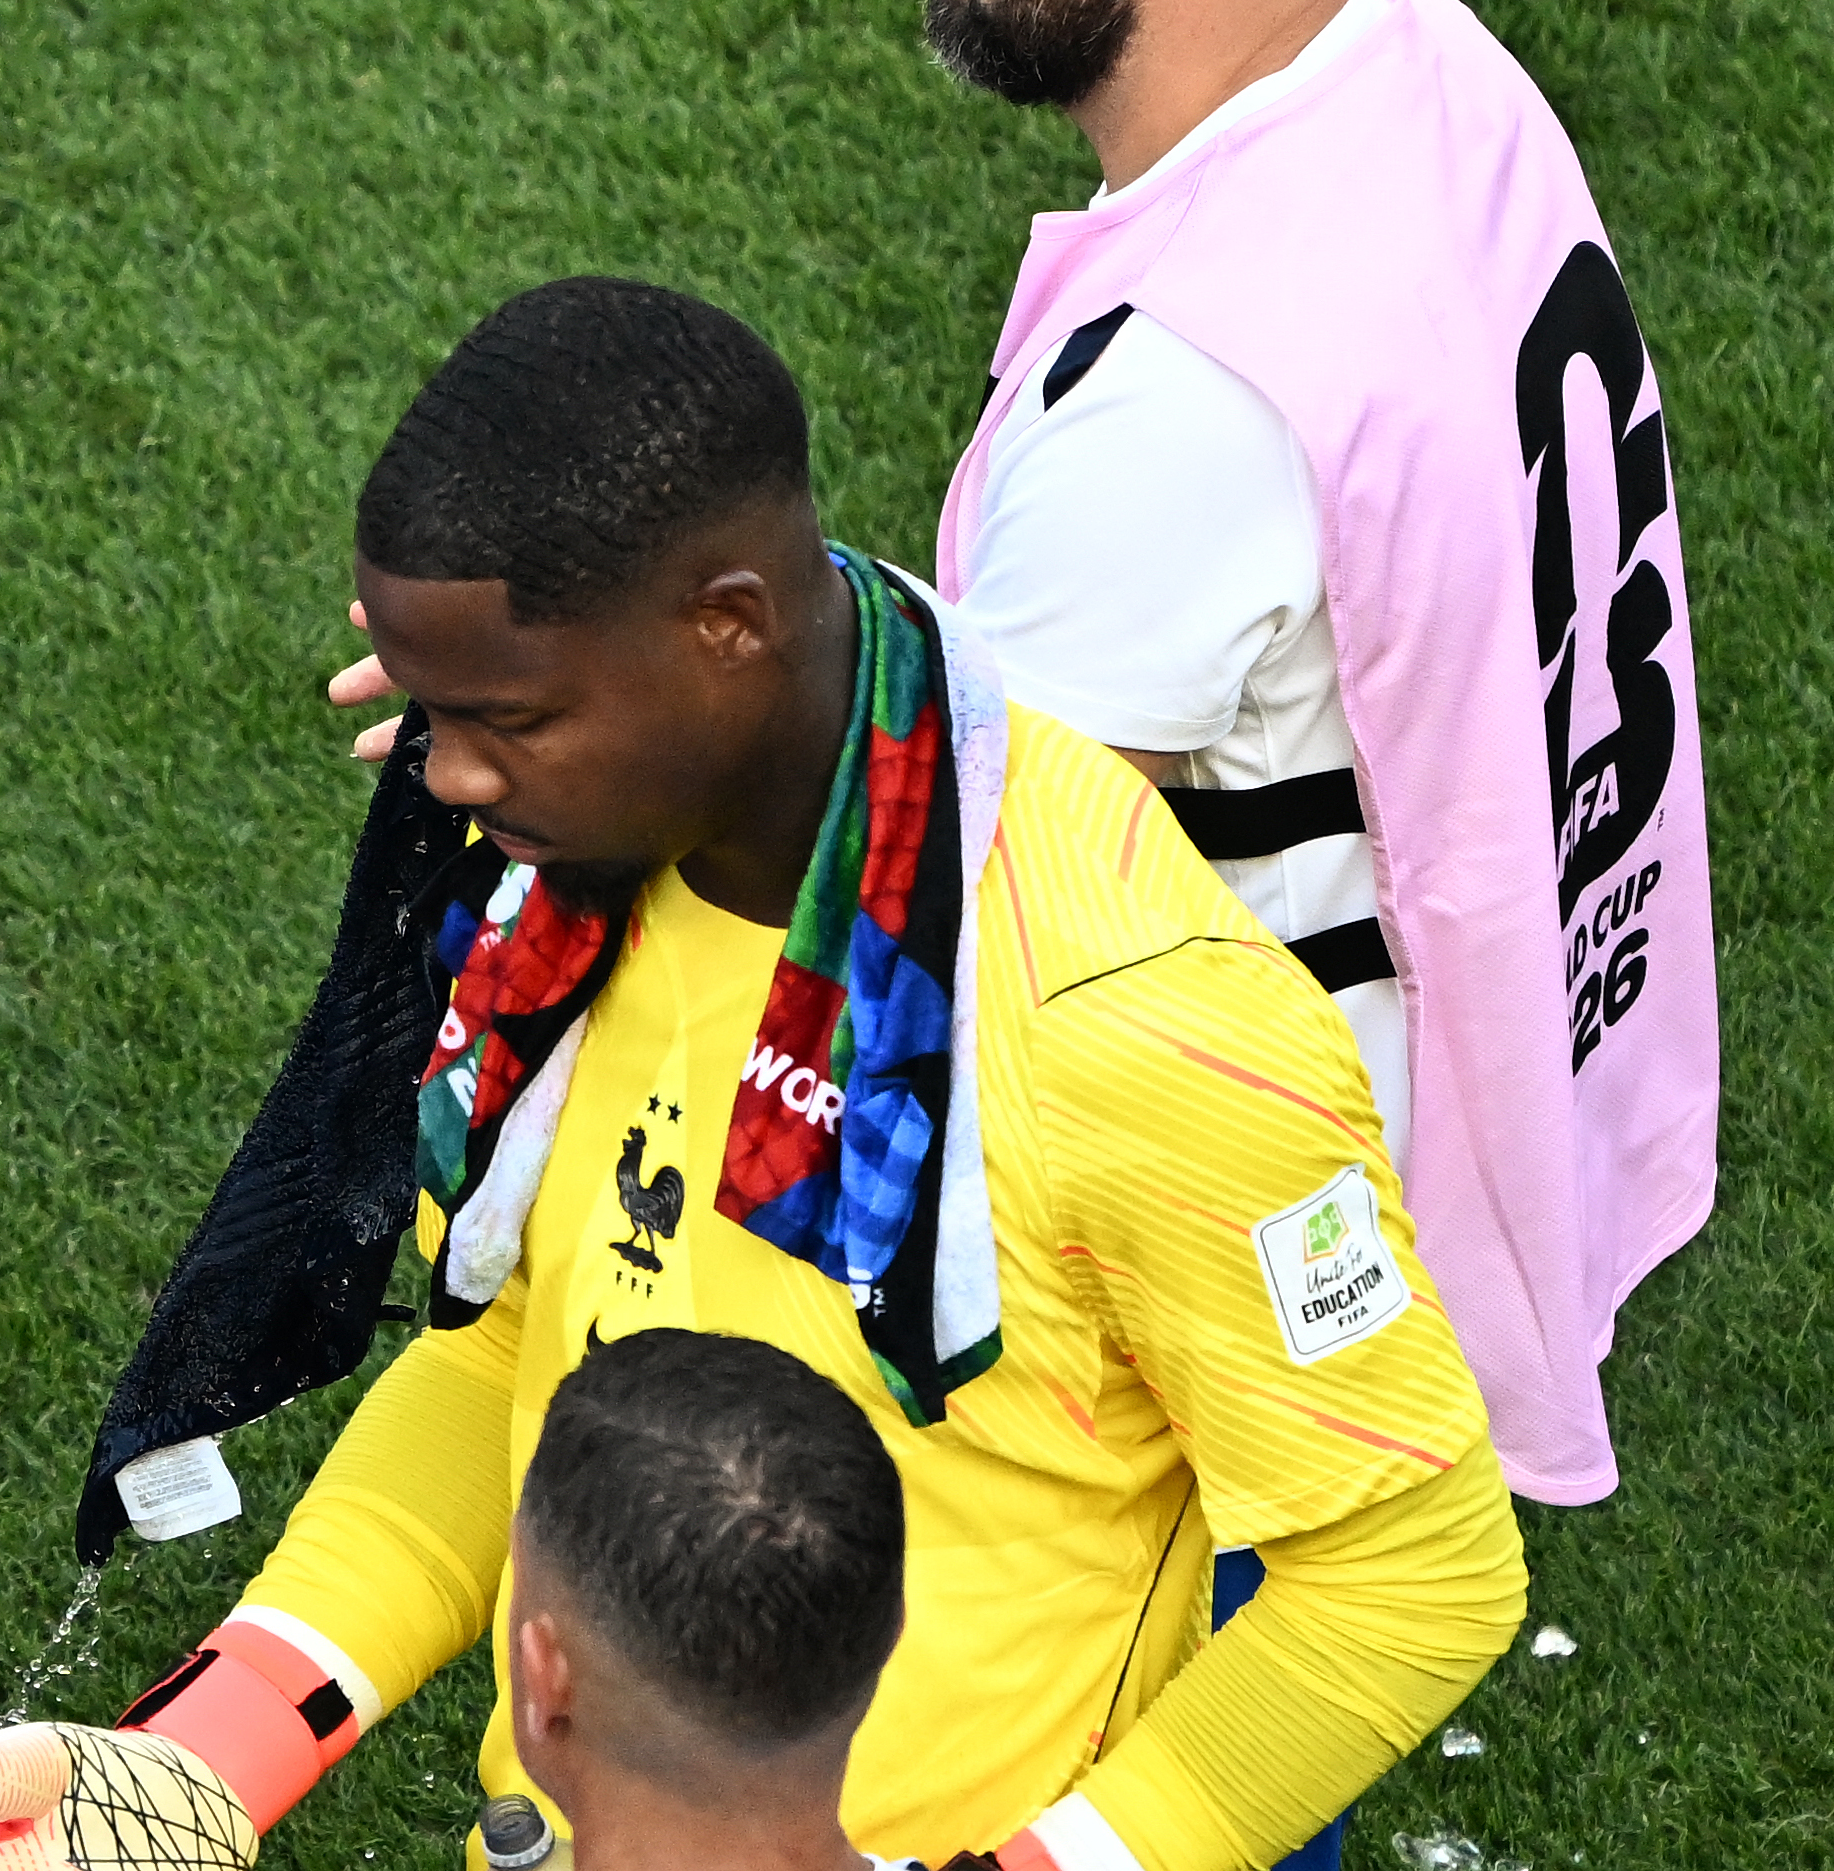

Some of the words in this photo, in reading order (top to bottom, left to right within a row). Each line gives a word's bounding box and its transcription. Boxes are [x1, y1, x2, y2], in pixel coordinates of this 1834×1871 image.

[1556, 761, 1621, 884] FFA
[1592, 859, 1662, 949] CUP
[1568, 927, 1650, 1079] 26
[1301, 1261, 1385, 1324] EDUCATION
[1306, 1259, 1347, 1294] Unite
[1347, 1242, 1364, 1272] For
[1337, 1305, 1369, 1329] FIFA
